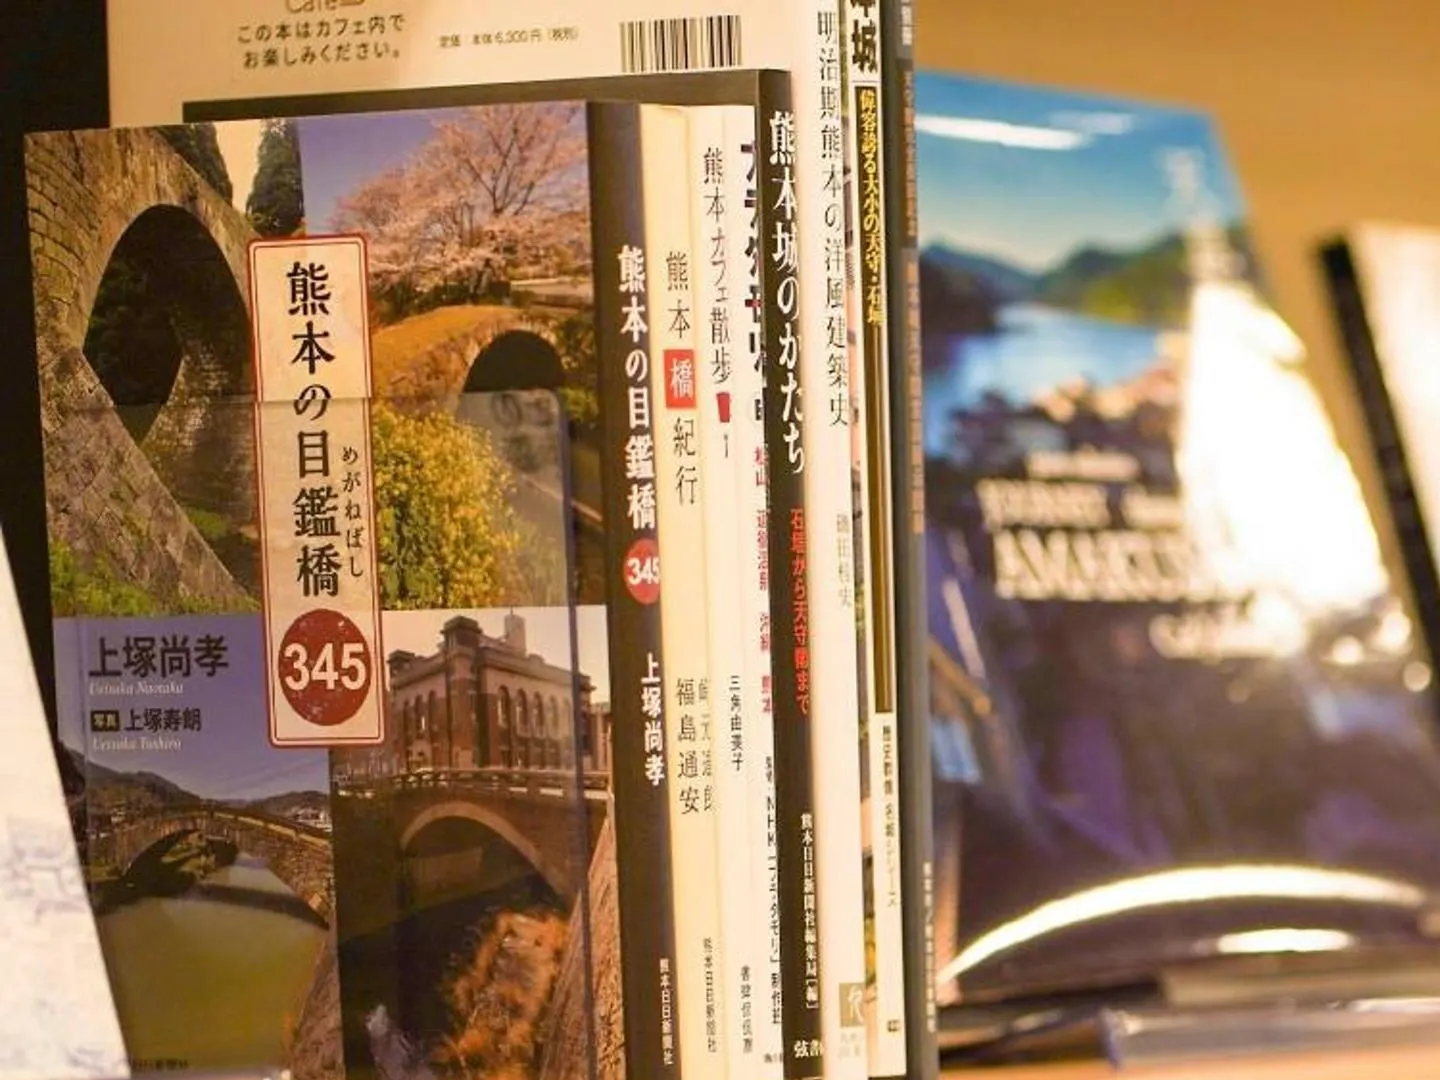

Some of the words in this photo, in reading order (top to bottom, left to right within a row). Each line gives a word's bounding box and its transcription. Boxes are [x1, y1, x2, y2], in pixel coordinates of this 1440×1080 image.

[237, 14, 406, 43] この本はカフェ内で
[243, 42, 401, 69] お楽しみください。
[703, 146, 733, 385] 熊本カフェ散歩
[817, 11, 849, 427] 明治期熊本の洋風建築史
[769, 109, 805, 474] 熊本城のかたち
[286, 261, 342, 597] 熊本の目鑑橋
[617, 244, 657, 530] 熊本の目鑑橋
[666, 250, 698, 506] 熊本橋紀行
[341, 446, 365, 578] めがねばし
[627, 556, 660, 585] 345
[88, 633, 230, 679] 上塚尚孝
[124, 706, 203, 733] 上塚寿朗
[284, 642, 367, 691] 345
[640, 652, 666, 786] 上塚尚孝
[676, 677, 701, 815] 福島通安
